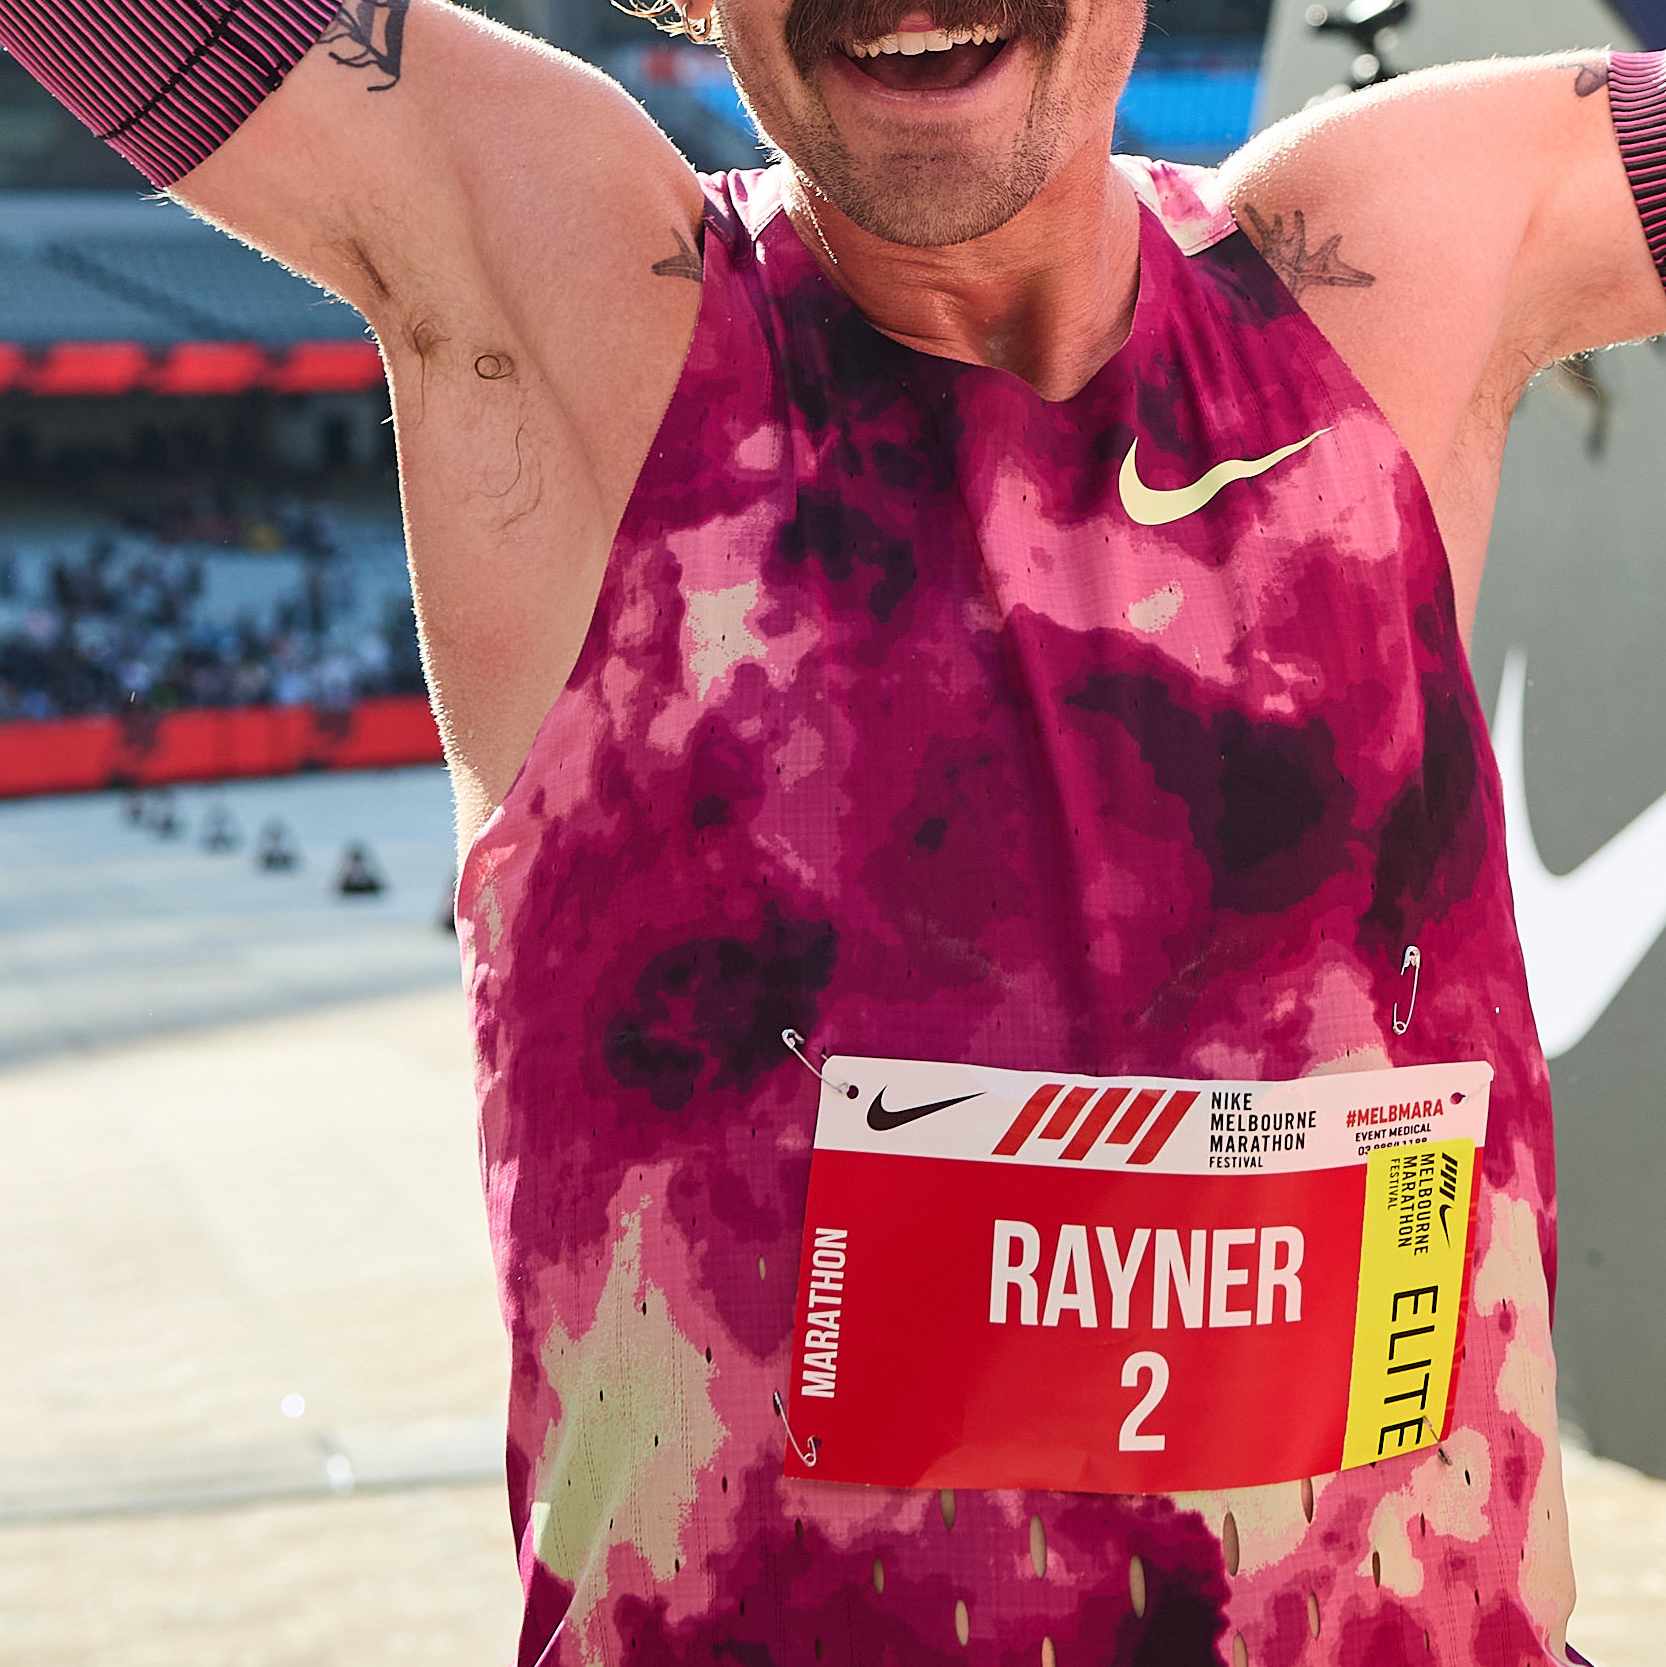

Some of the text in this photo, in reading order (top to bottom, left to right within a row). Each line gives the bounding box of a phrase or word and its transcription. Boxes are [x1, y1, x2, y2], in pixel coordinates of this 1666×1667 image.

[1209, 1110, 1318, 1133] MELBOURNE
[1210, 1091, 1253, 1112] NIKE
[1345, 1098, 1445, 1129] #MELBMARA
[1208, 1132, 1307, 1154] MARATHON
[1354, 1122, 1432, 1143] EVENT MEDICAL
[1208, 1156, 1265, 1169] FESTIVAL
[1386, 1157, 1401, 1211] FESTIVAL
[1397, 1155, 1419, 1249] MARATHON
[1413, 1152, 1436, 1257] MELBOURNE
[988, 1218, 1305, 1331] RAYNER
[800, 1226, 850, 1400] MARATHON
[1377, 1284, 1439, 1456] ELITE
[1117, 1350, 1171, 1453] 2
